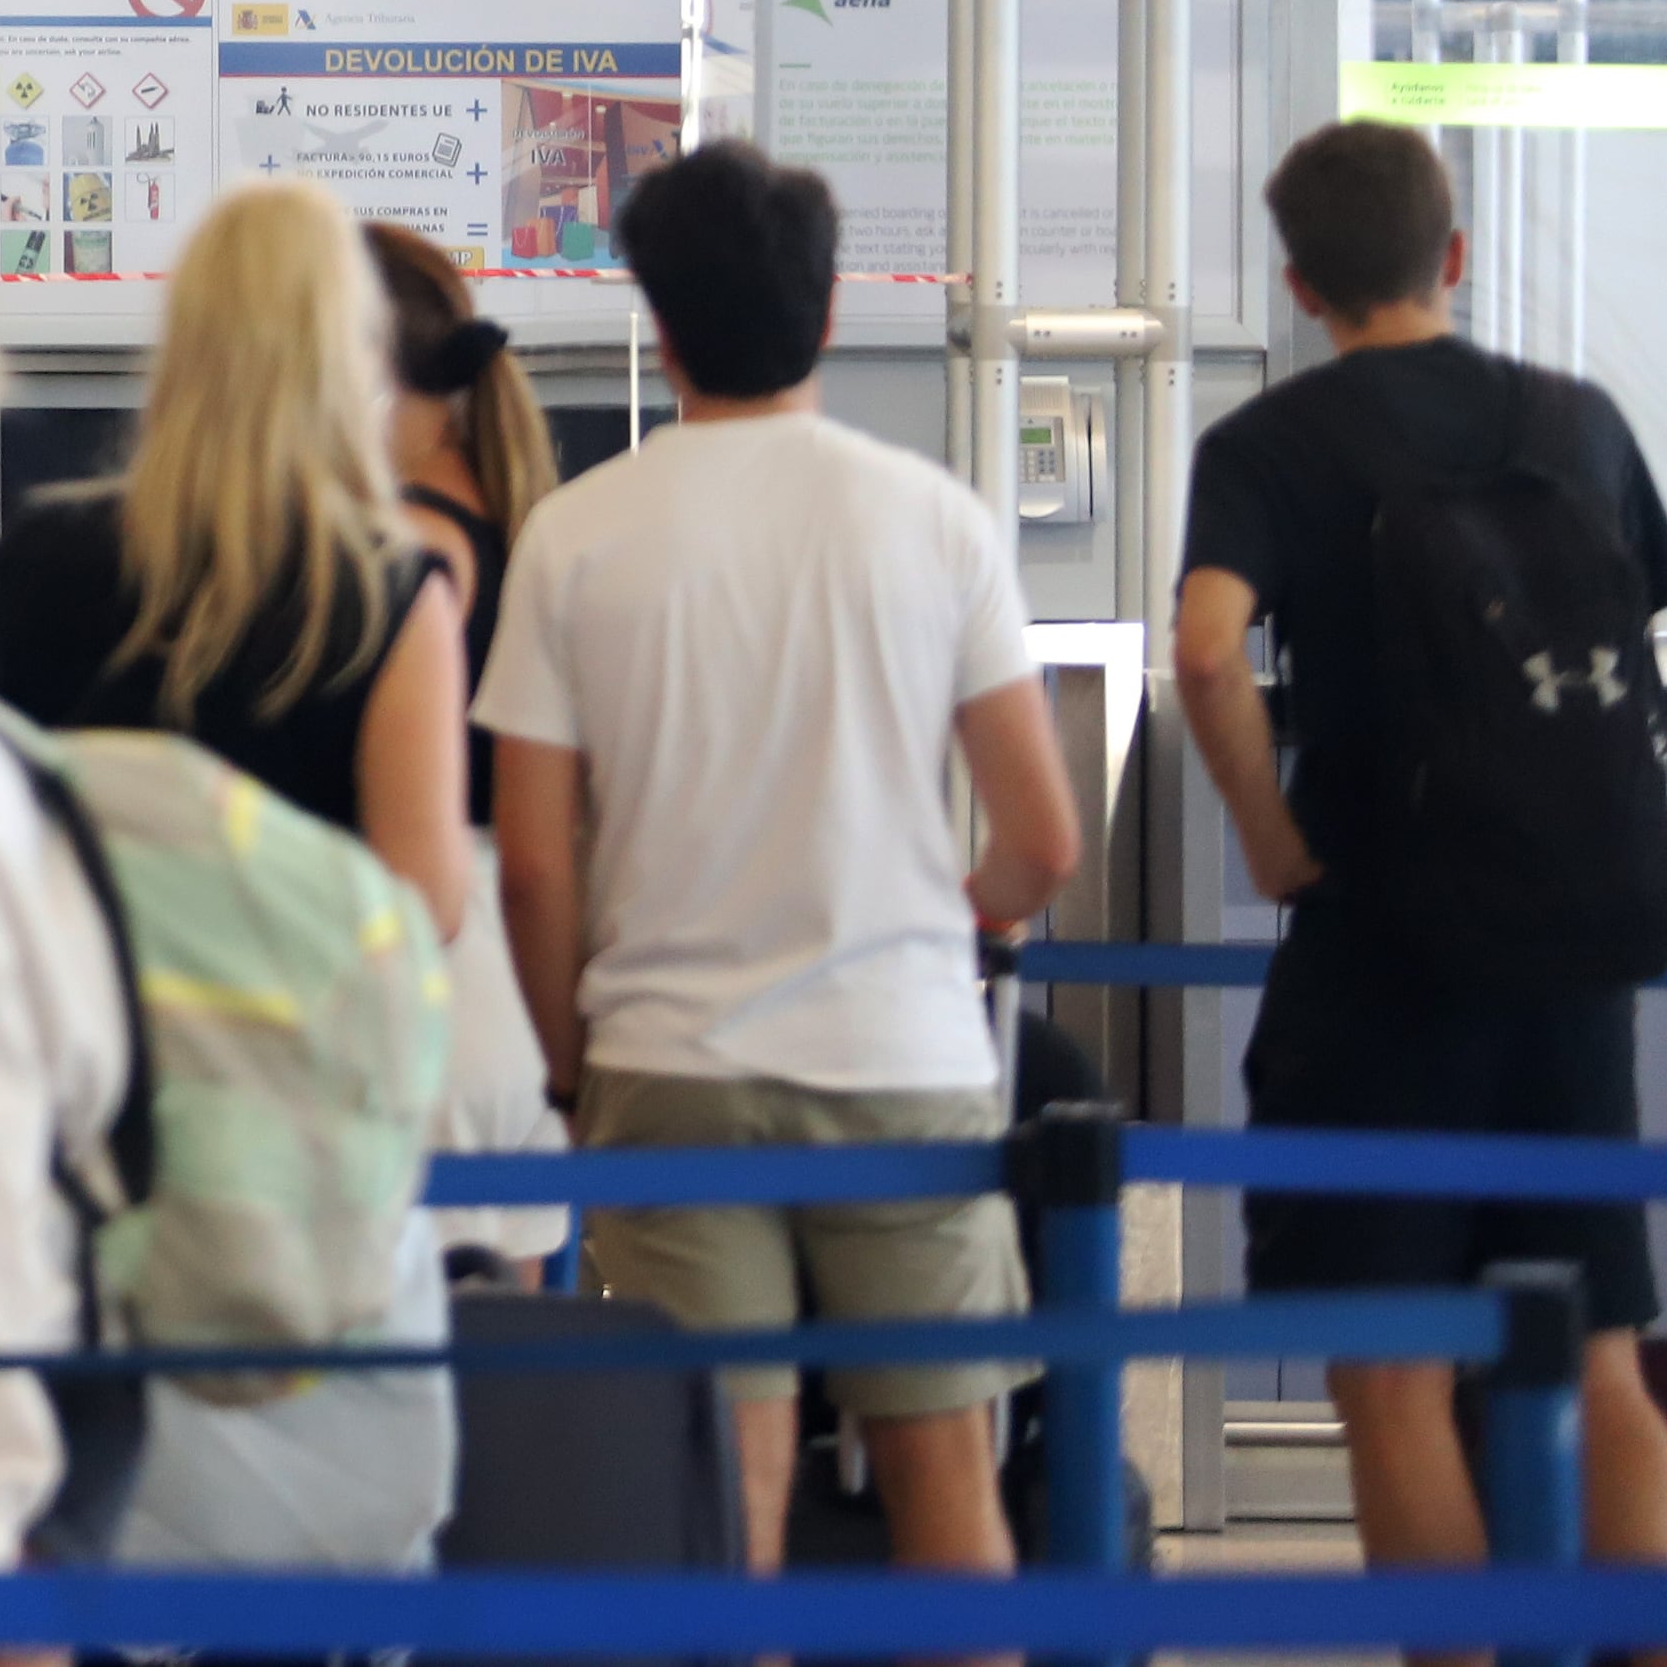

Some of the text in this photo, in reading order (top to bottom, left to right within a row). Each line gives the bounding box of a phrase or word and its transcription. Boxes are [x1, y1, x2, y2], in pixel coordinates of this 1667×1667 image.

[326, 45, 618, 73] DEVOLUCIÓN DE IVA
[307, 105, 451, 116] NO RESIDENTES UE
[393, 153, 429, 162] EUROS
[531, 148, 567, 166] IVA
[388, 169, 454, 179] COMERCIAL
